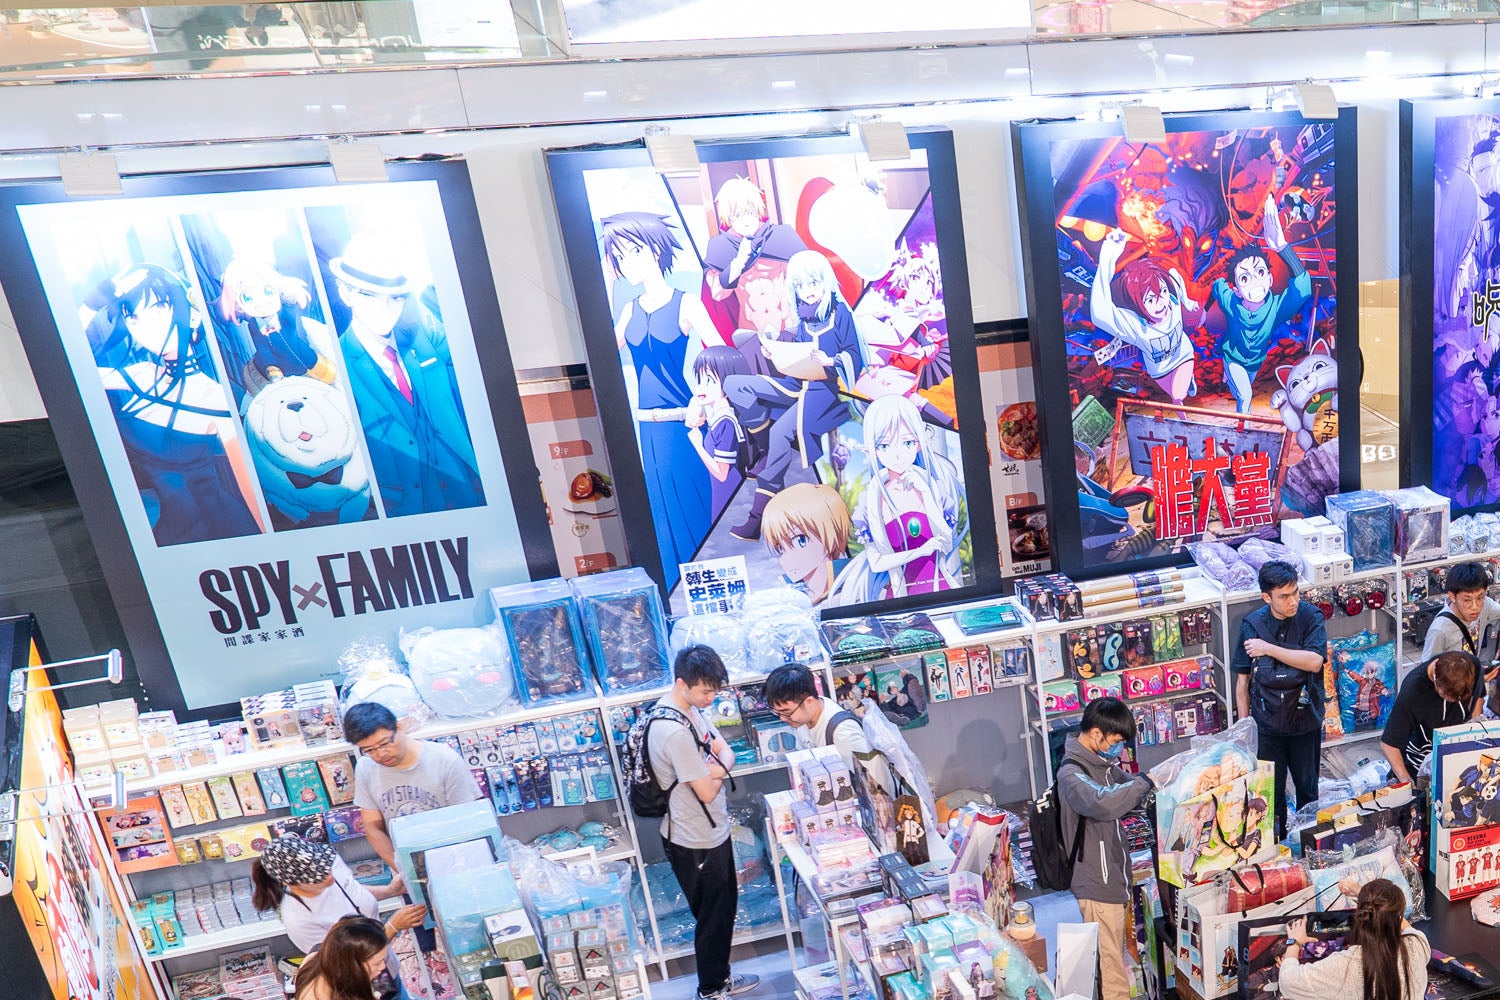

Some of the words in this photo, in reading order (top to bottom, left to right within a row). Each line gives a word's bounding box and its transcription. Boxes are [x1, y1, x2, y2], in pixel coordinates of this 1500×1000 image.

[553, 446, 569, 456] 9/F
[1008, 497, 1023, 507] B/F
[579, 557, 594, 569] 2/F
[1023, 562, 1042, 573] MUJI
[224, 626, 305, 648] 間諜家家酒
